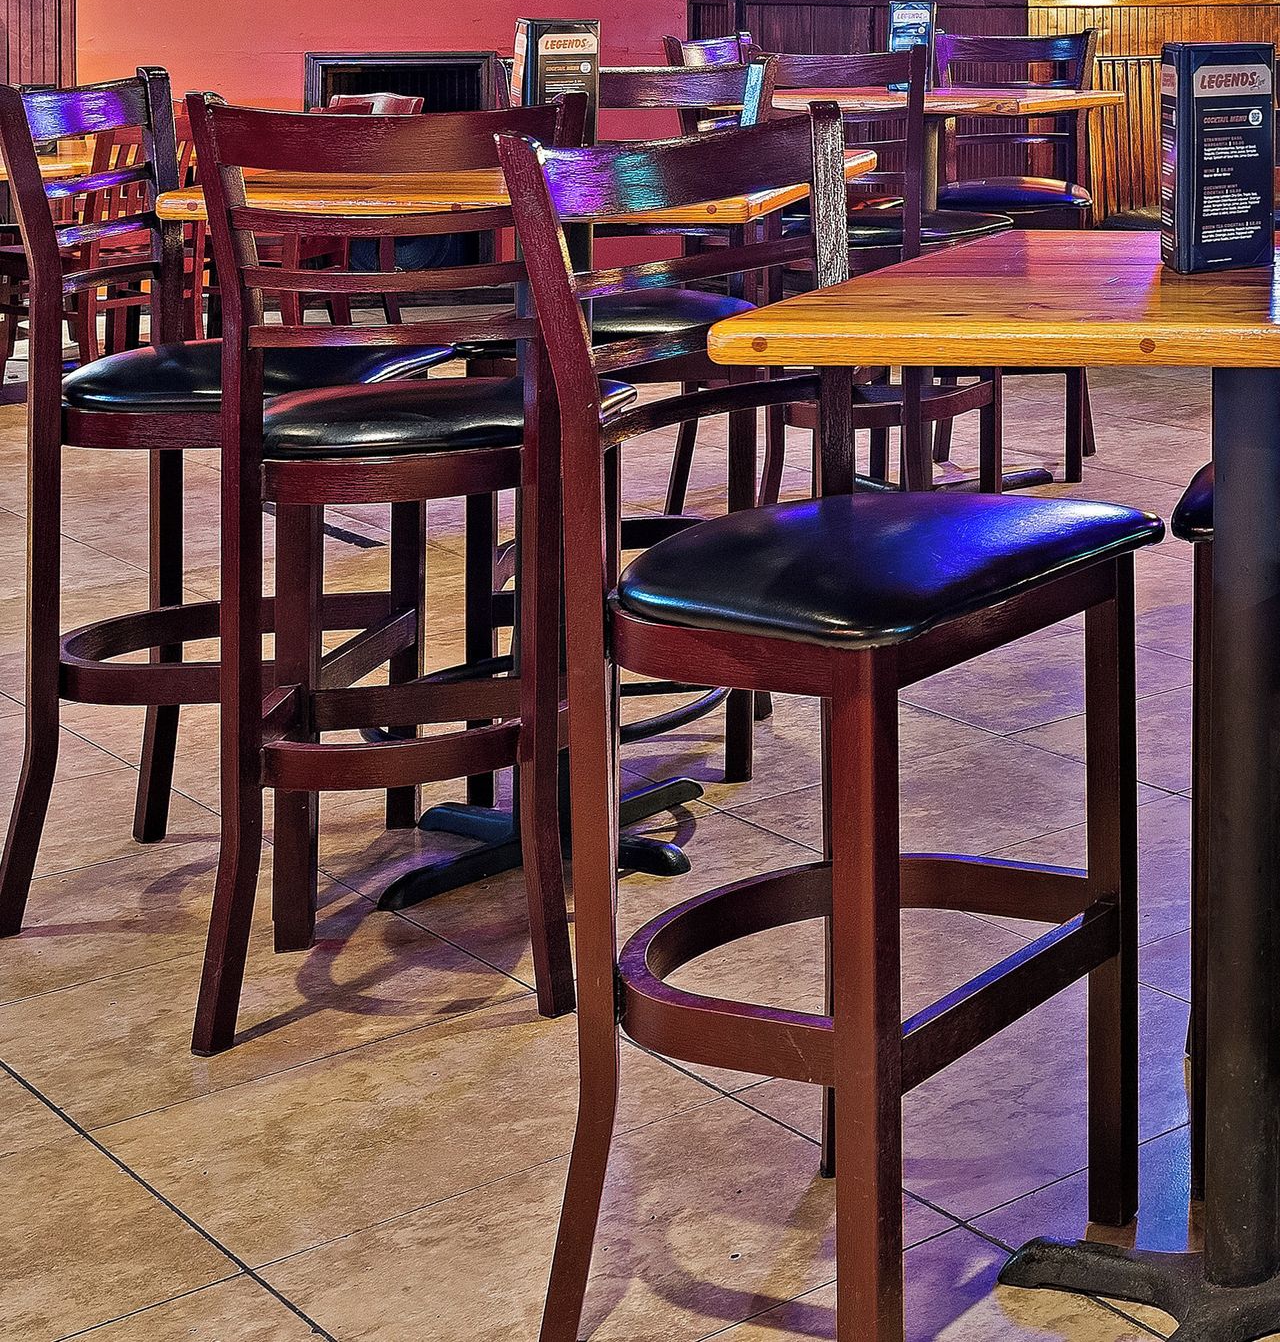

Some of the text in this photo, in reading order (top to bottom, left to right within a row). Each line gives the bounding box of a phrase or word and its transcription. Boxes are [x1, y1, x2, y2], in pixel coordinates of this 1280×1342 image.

[544, 38, 587, 50] LEGENDS
[1200, 72, 1257, 90] LEGENDS
[1203, 115, 1229, 124] COCKTAIL
